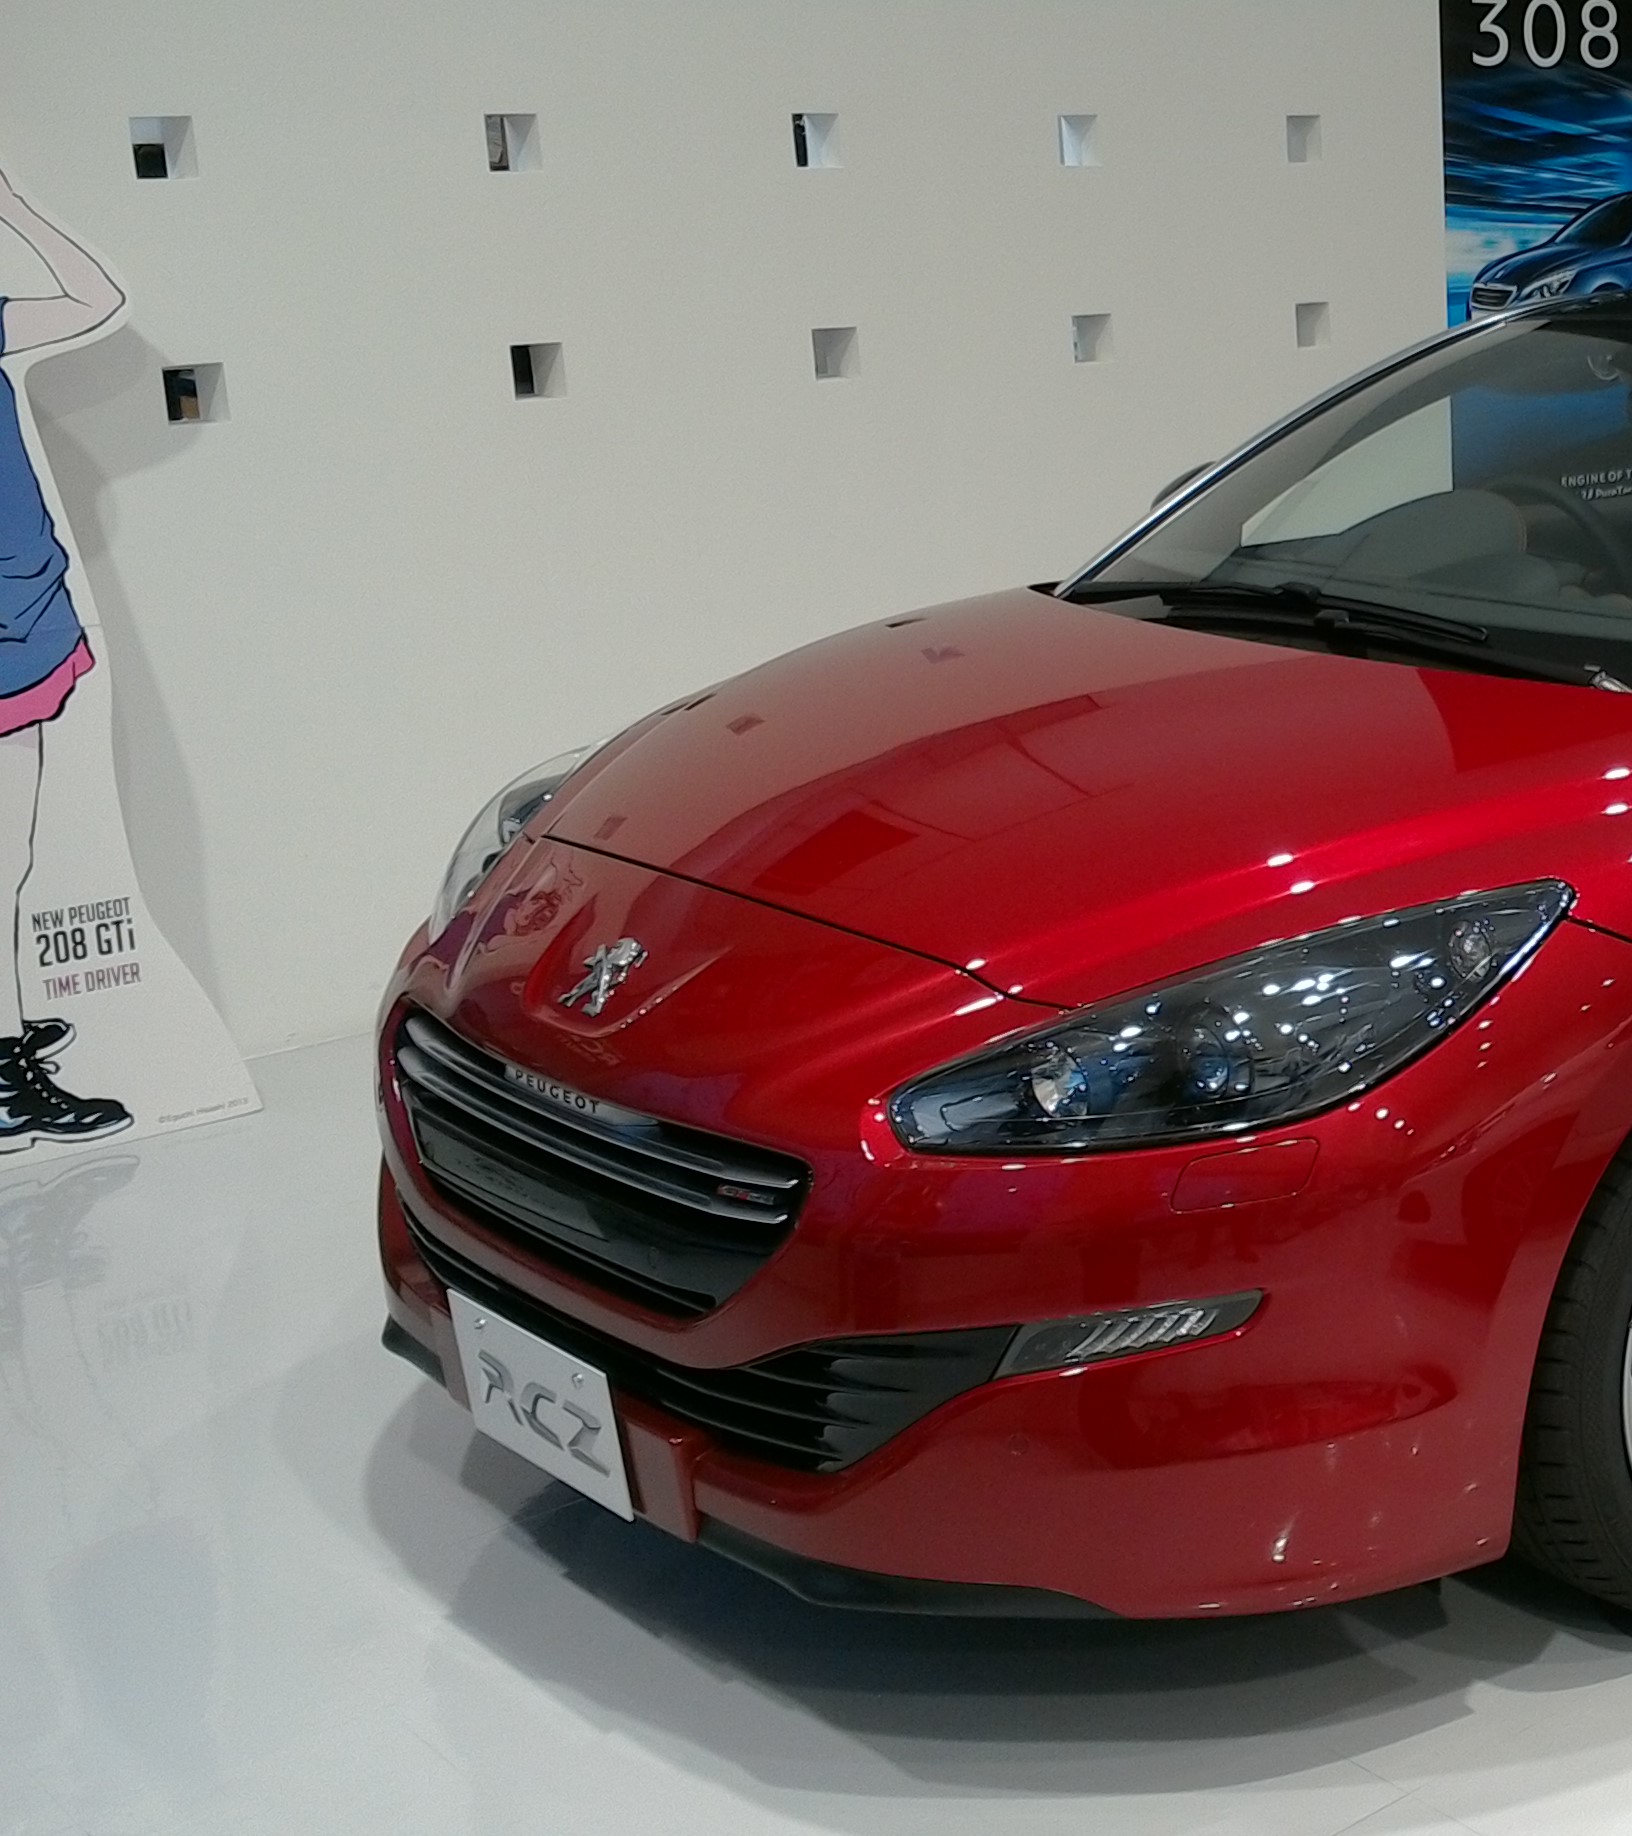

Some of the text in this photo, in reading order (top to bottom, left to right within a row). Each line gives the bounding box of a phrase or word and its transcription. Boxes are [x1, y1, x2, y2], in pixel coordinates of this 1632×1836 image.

[1471, 0, 1619, 68] 308
[1561, 472, 1606, 487] ENGINE
[1607, 469, 1623, 482] OF
[31, 897, 130, 932] NEW PEUGEOT
[35, 917, 136, 967] 208 GTi
[43, 962, 142, 1001] TIME DRIVER
[515, 1069, 600, 1113] PEUGEOT
[477, 1349, 611, 1479] RCZ
